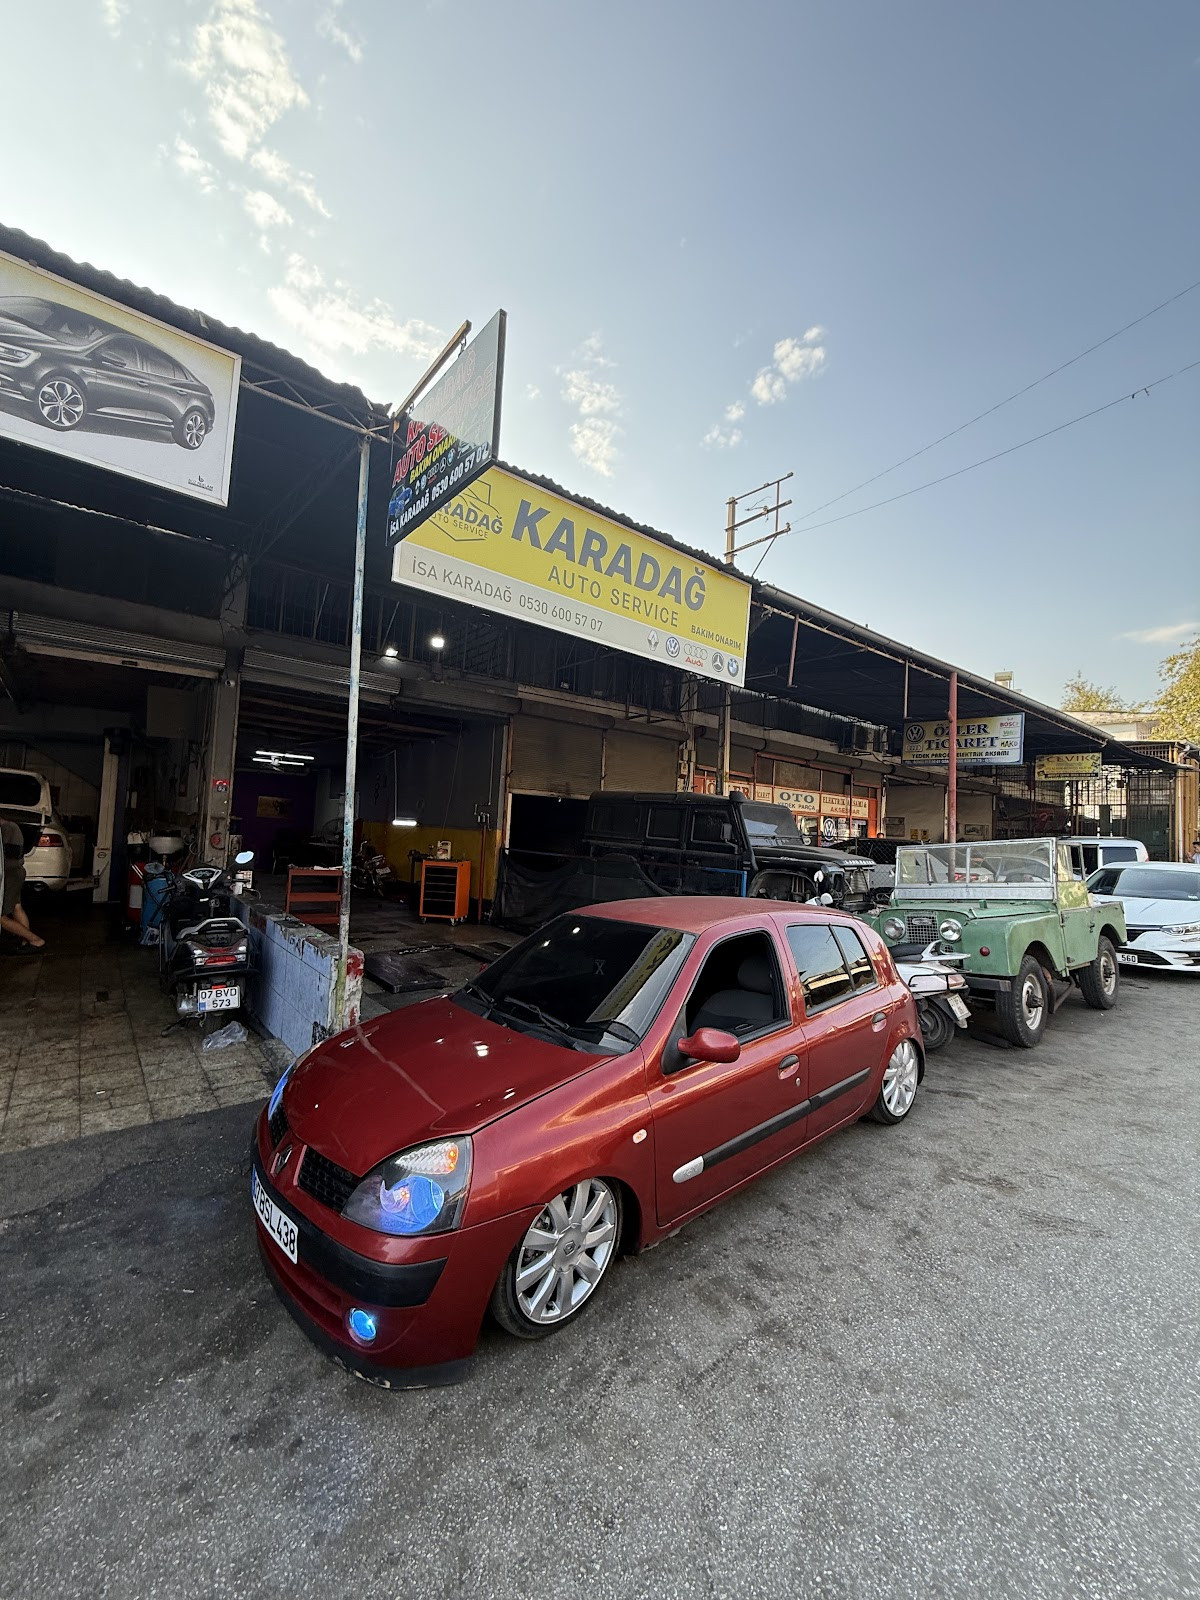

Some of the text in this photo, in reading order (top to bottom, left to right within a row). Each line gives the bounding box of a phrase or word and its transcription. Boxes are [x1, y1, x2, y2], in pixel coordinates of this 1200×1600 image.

[392, 434, 426, 488] AUTO
[409, 455, 432, 484] BAKIM
[389, 520, 400, 537] İSA
[400, 489, 430, 526] KARADAĞ
[431, 475, 449, 501] 0530
[449, 465, 464, 486] 600
[464, 452, 475, 473] 57
[431, 512, 489, 539] UTO SERVICE
[438, 502, 504, 535] RADAĞ
[511, 499, 706, 611] KARADAĞ
[412, 556, 603, 632] İSA KARADAĞ 0530 600 57 07
[548, 565, 679, 628] AUTO SERVICE
[691, 624, 742, 651] BAKIM ONARIM
[934, 723, 991, 737] ÖLER
[780, 791, 815, 804] OTO
[830, 806, 860, 815] AKSESAR
[1121, 954, 1136, 963] 560
[200, 988, 237, 999] 07 BVD
[212, 999, 231, 1008] 573
